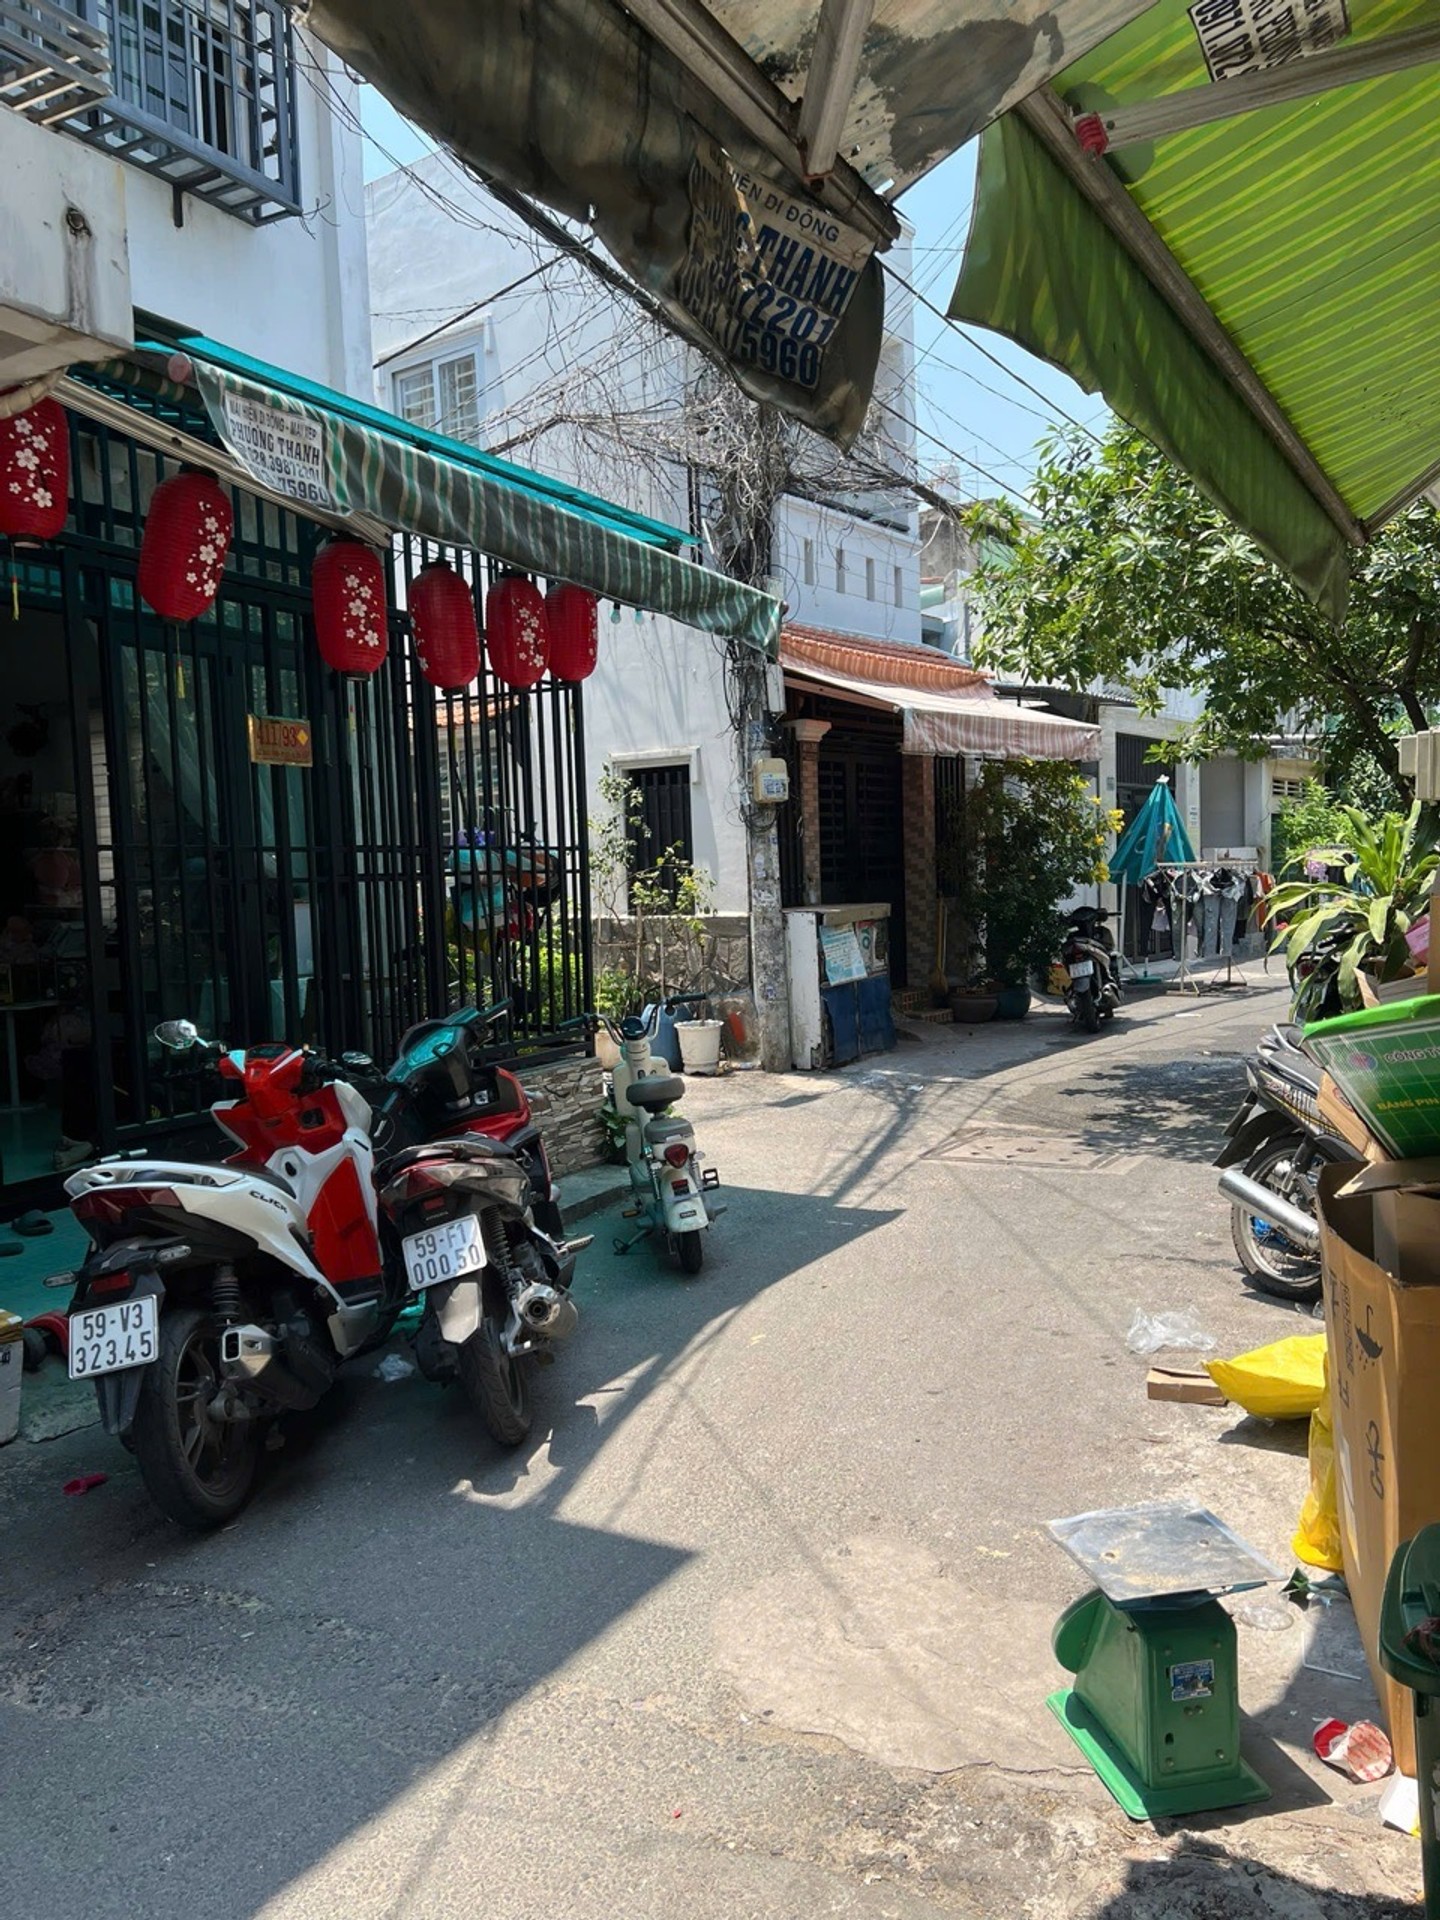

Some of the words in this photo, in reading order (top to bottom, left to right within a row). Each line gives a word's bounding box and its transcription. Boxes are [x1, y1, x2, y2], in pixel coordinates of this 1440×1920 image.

[1195, 0, 1260, 82] 0971.072.
[765, 193, 784, 214] DI
[785, 208, 840, 243] ĐỘNG
[752, 224, 859, 316] THANH
[277, 436, 320, 466] THANH
[249, 1190, 288, 1214] CLICK
[414, 1222, 467, 1259] 59-F1
[413, 1243, 481, 1284] 000.50
[83, 1303, 143, 1342] 59-V3
[75, 1331, 152, 1374] 323.45
